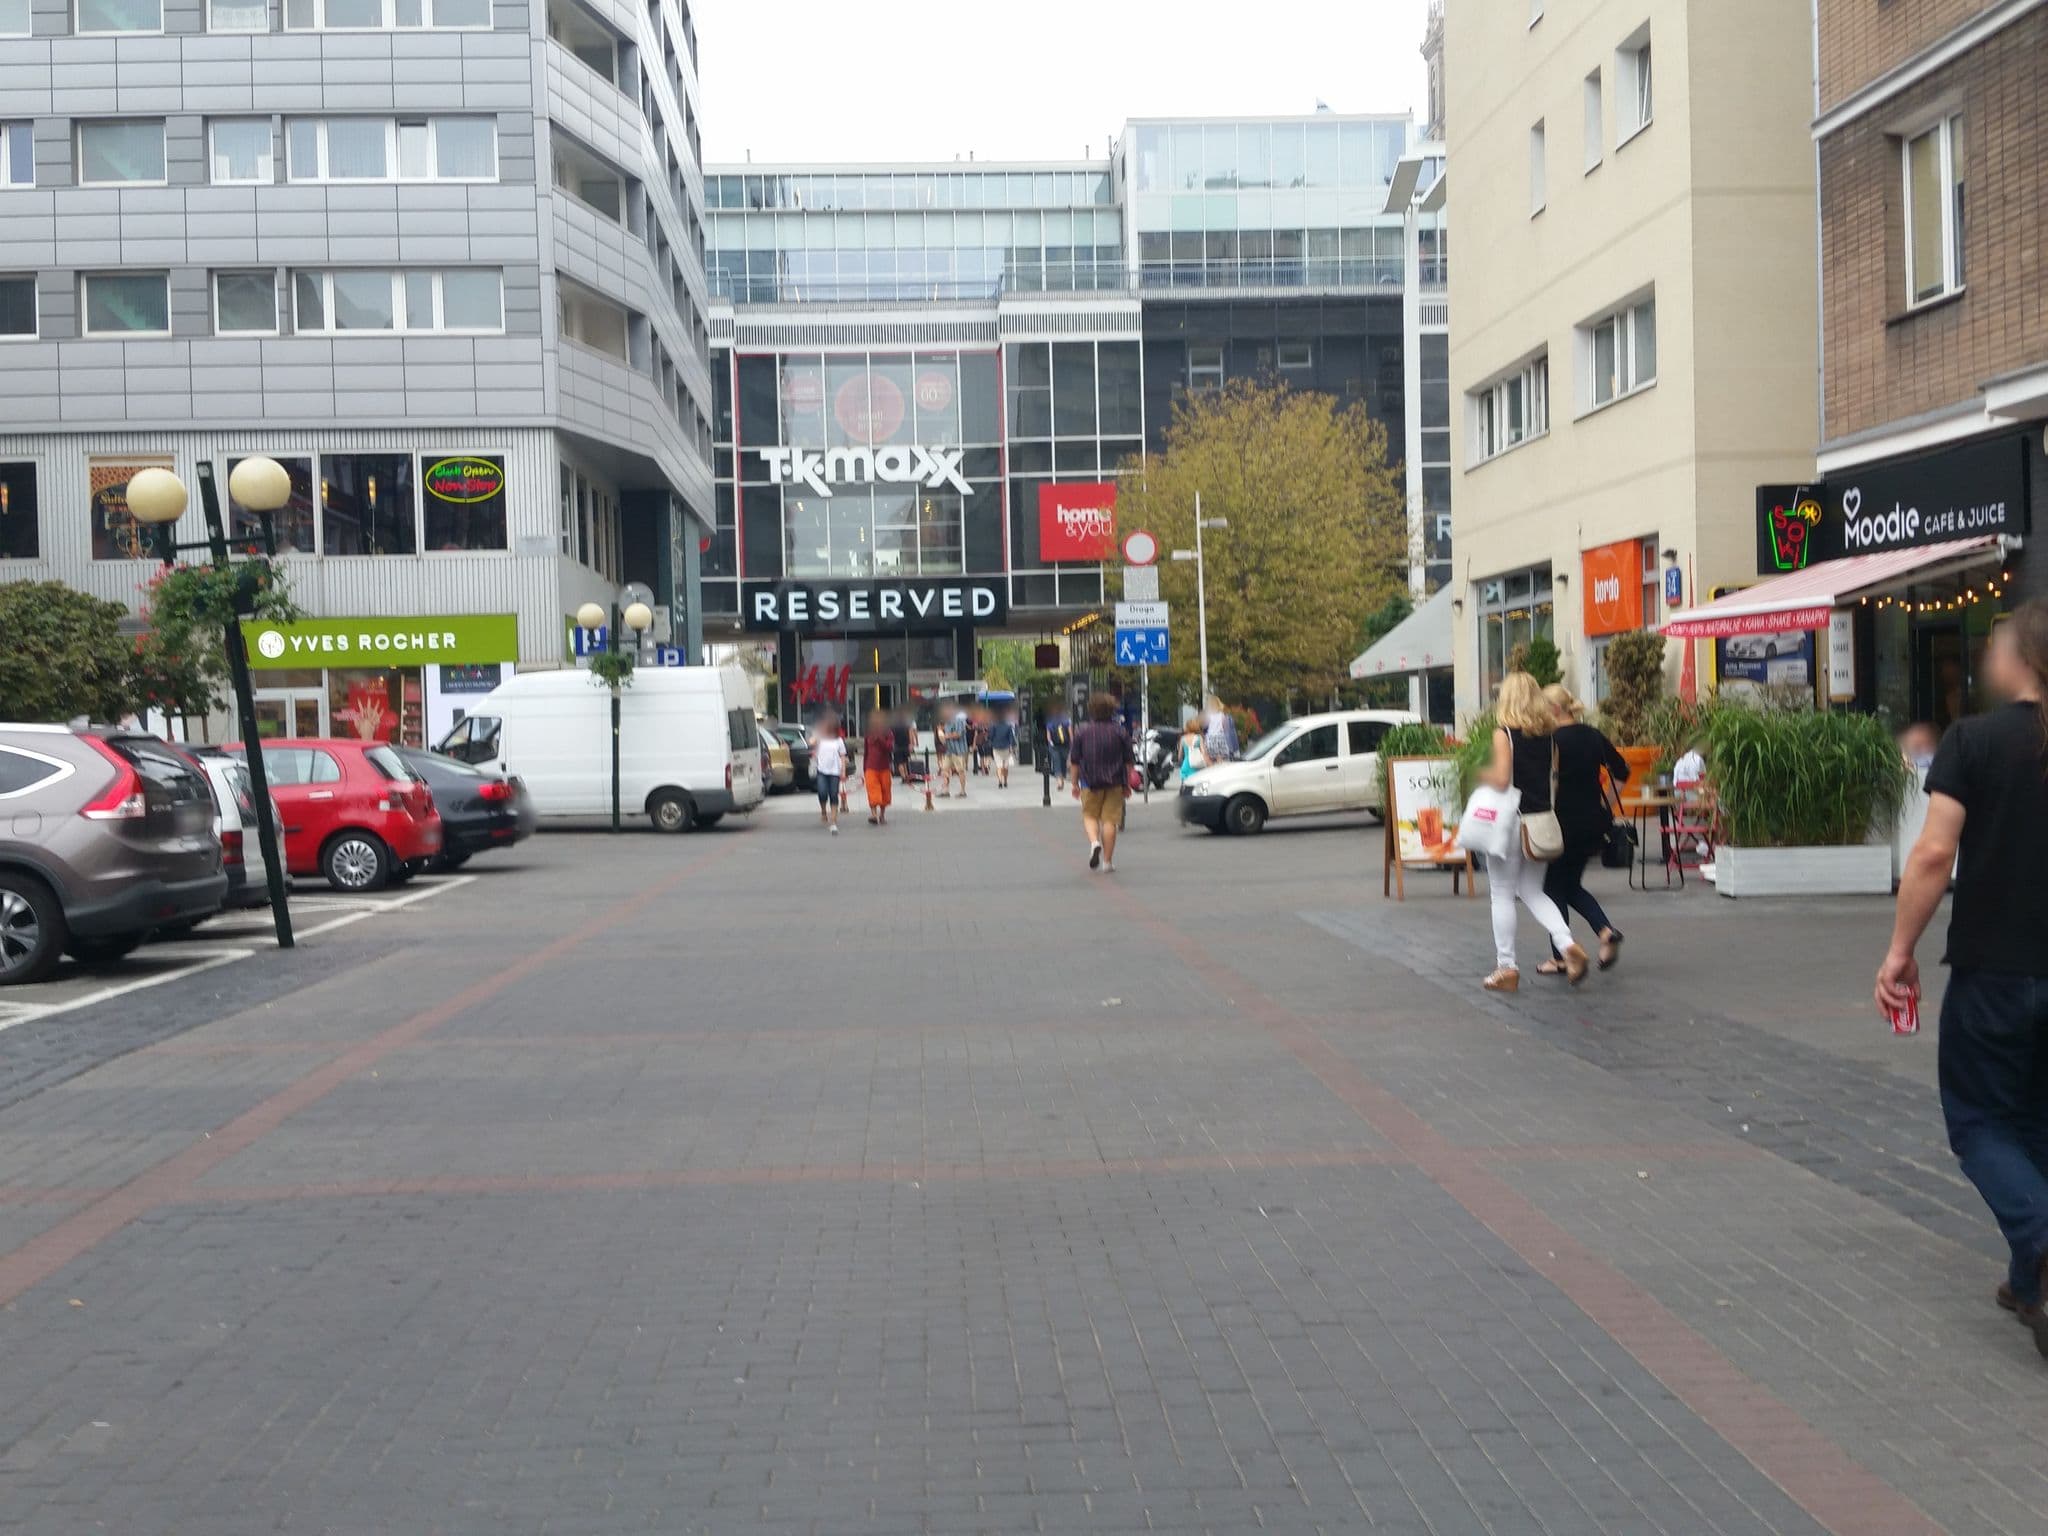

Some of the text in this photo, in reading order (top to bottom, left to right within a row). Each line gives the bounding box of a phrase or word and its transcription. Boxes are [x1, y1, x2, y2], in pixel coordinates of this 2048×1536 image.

[1057, 503, 1111, 524] home
[1924, 509, 1955, 535] CAFÉ
[1957, 513, 1965, 529] &
[1967, 502, 2006, 528] JUICE
[754, 587, 997, 621] RESERVED
[1594, 573, 1620, 604] bordo
[290, 632, 457, 652] YVES ROCHER
